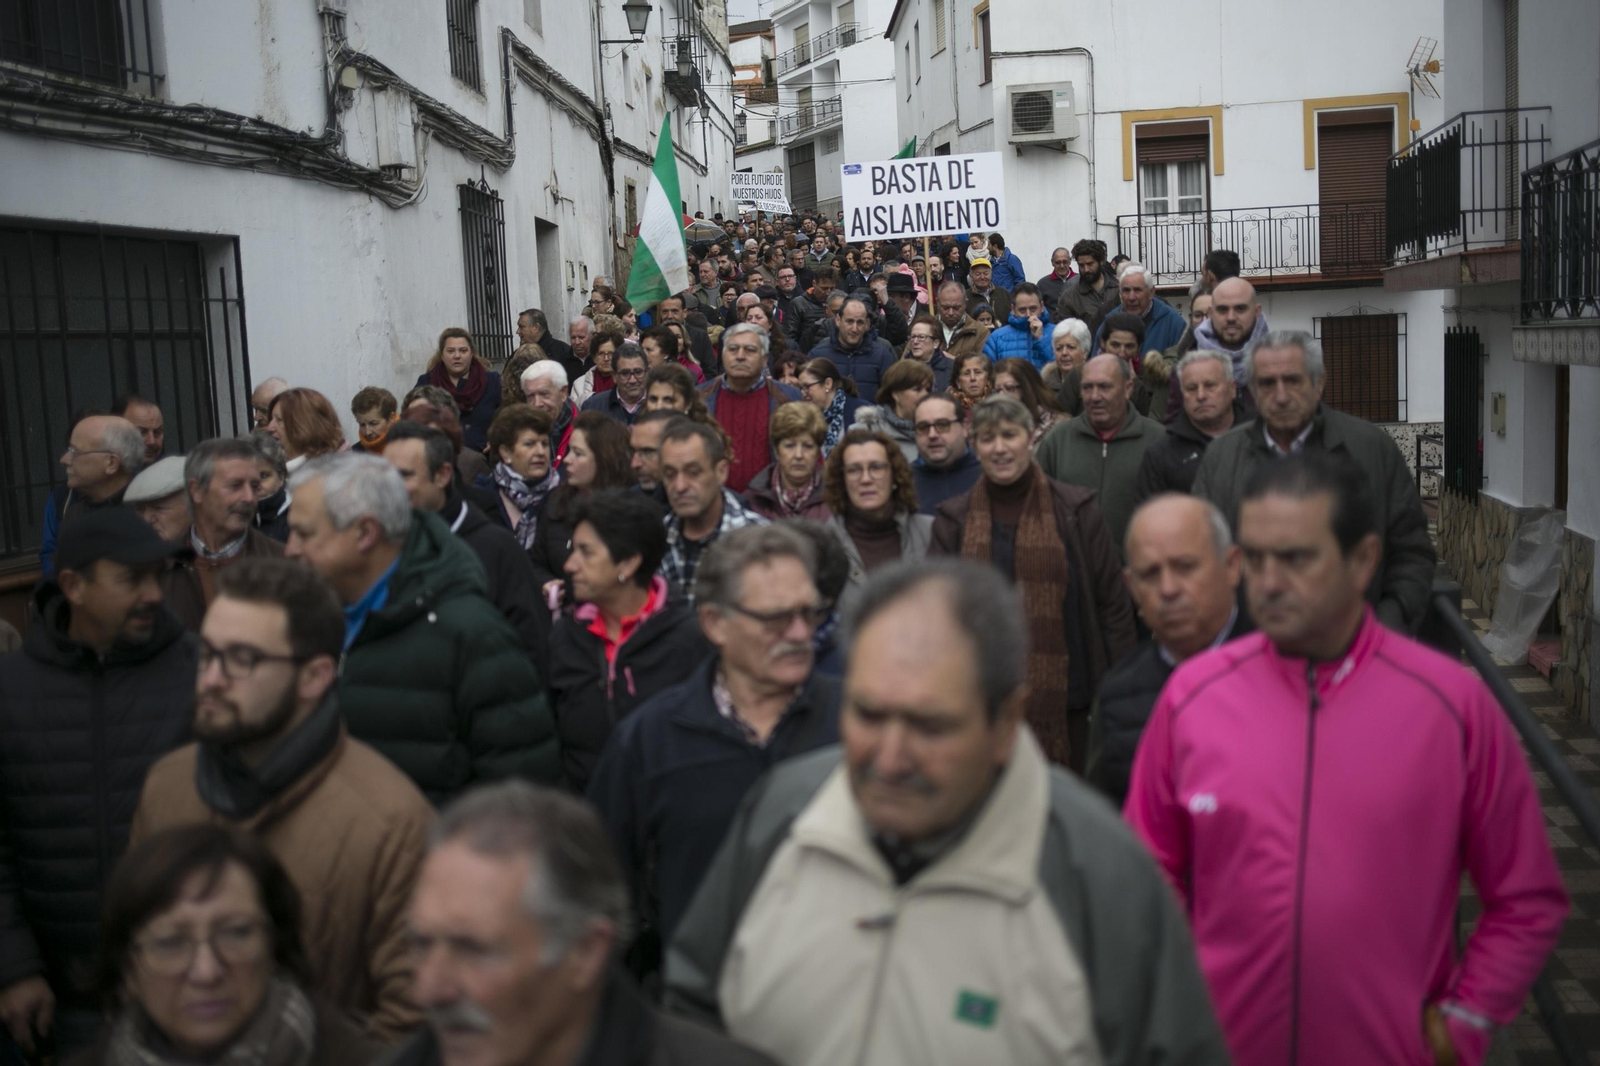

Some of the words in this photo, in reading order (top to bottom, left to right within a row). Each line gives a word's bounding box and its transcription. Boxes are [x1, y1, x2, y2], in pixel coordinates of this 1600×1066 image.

[731, 174, 743, 185] POR
[744, 174, 751, 185] EL
[752, 174, 774, 185] FUTURO
[775, 174, 783, 185] DE
[871, 162, 943, 196] BASTA
[947, 159, 976, 190] DE
[733, 188, 764, 199] NUESTROS
[765, 188, 782, 199] HIJOS
[850, 197, 1000, 237] AISLAMIENTO
